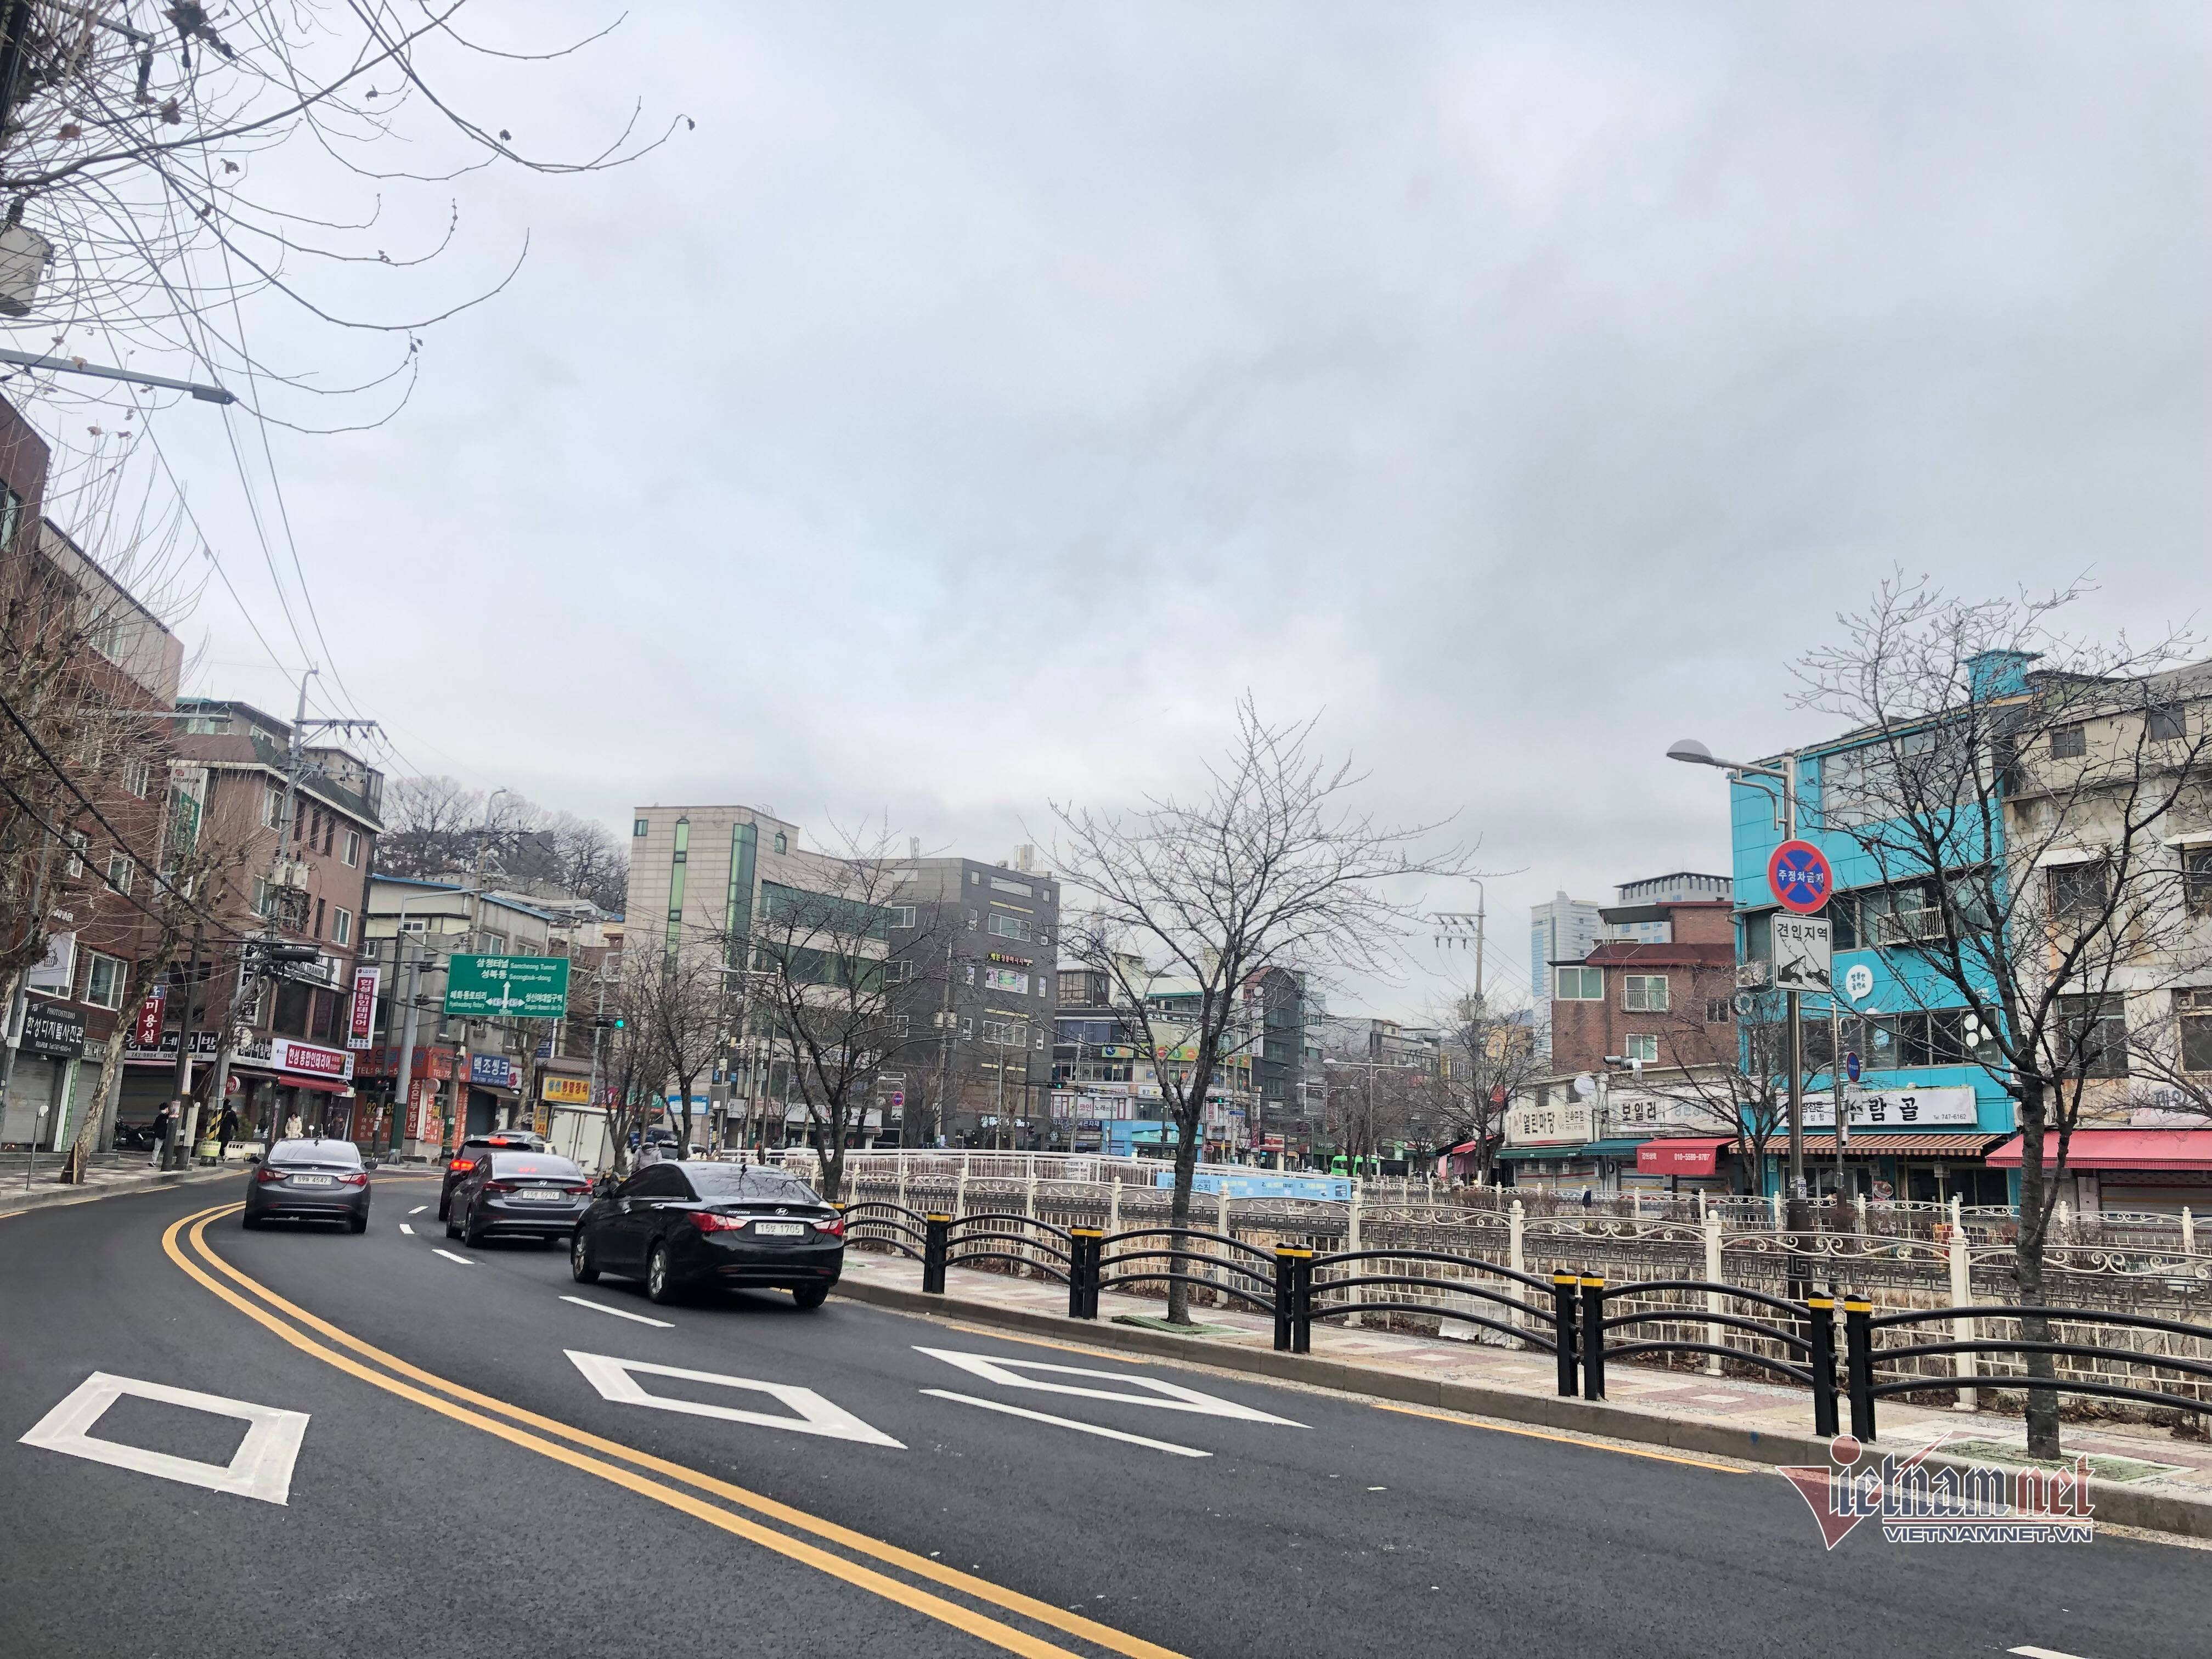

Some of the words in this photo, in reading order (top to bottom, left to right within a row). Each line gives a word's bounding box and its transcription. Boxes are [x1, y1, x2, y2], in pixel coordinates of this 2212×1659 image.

[1778, 868, 1825, 884] 주정차금지
[1776, 922, 1828, 941] 견인지역
[476, 958, 509, 969] 삼청터널
[481, 970, 507, 979] 성북동
[47, 1007, 76, 1020] PHOTOSTUDIO
[140, 999, 159, 1043] 미용실
[25, 1015, 84, 1043] 한성디지털사진관
[288, 1047, 300, 1065] 한성
[300, 1049, 331, 1070] 종합인테리어
[363, 1048, 425, 1068] 조은부산
[408, 1080, 420, 1132] 조은부동산
[1079, 1103, 1092, 1111] 코인
[1622, 1102, 1657, 1121] 보일러
[1523, 1111, 1555, 1134] 열린마당
[780, 1224, 800, 1234] 1705
